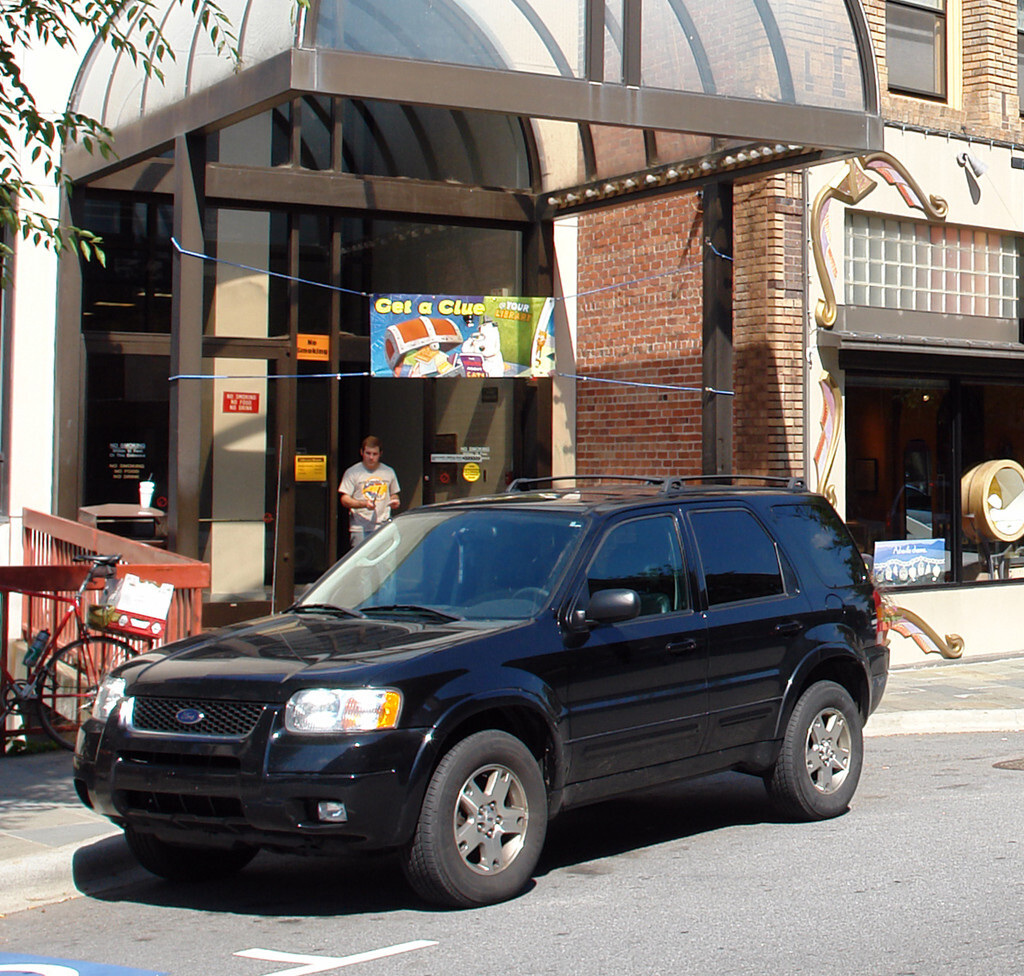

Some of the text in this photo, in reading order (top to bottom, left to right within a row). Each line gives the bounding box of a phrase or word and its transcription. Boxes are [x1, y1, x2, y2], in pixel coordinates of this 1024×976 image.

[374, 297, 486, 316] Get a Clue
